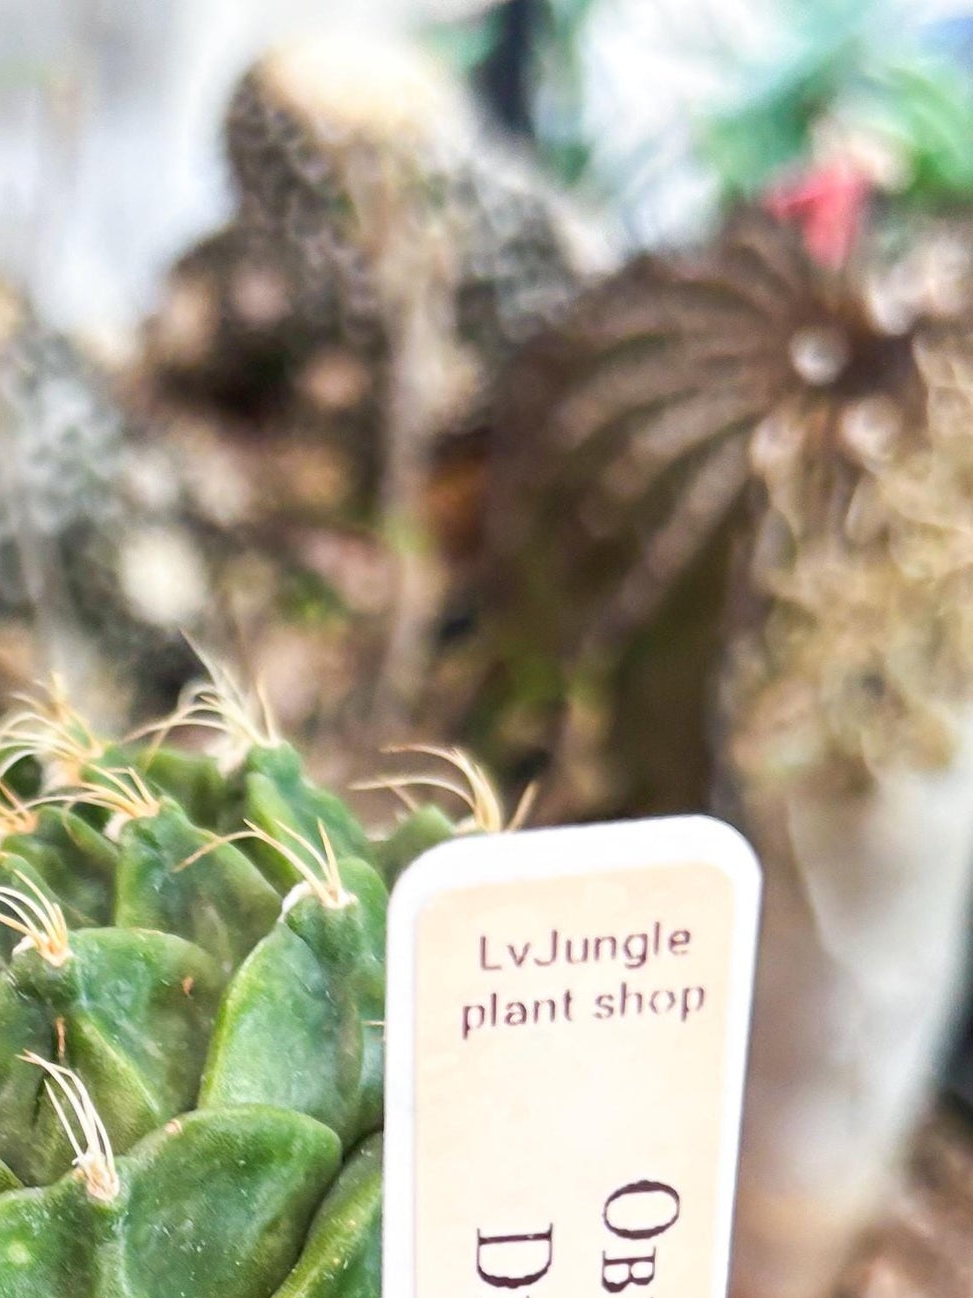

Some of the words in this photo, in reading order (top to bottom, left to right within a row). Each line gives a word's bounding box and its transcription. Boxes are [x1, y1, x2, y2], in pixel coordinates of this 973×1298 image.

[478, 920, 693, 972] LvJungle
[461, 984, 575, 1039] plant
[593, 981, 707, 1022] shop
